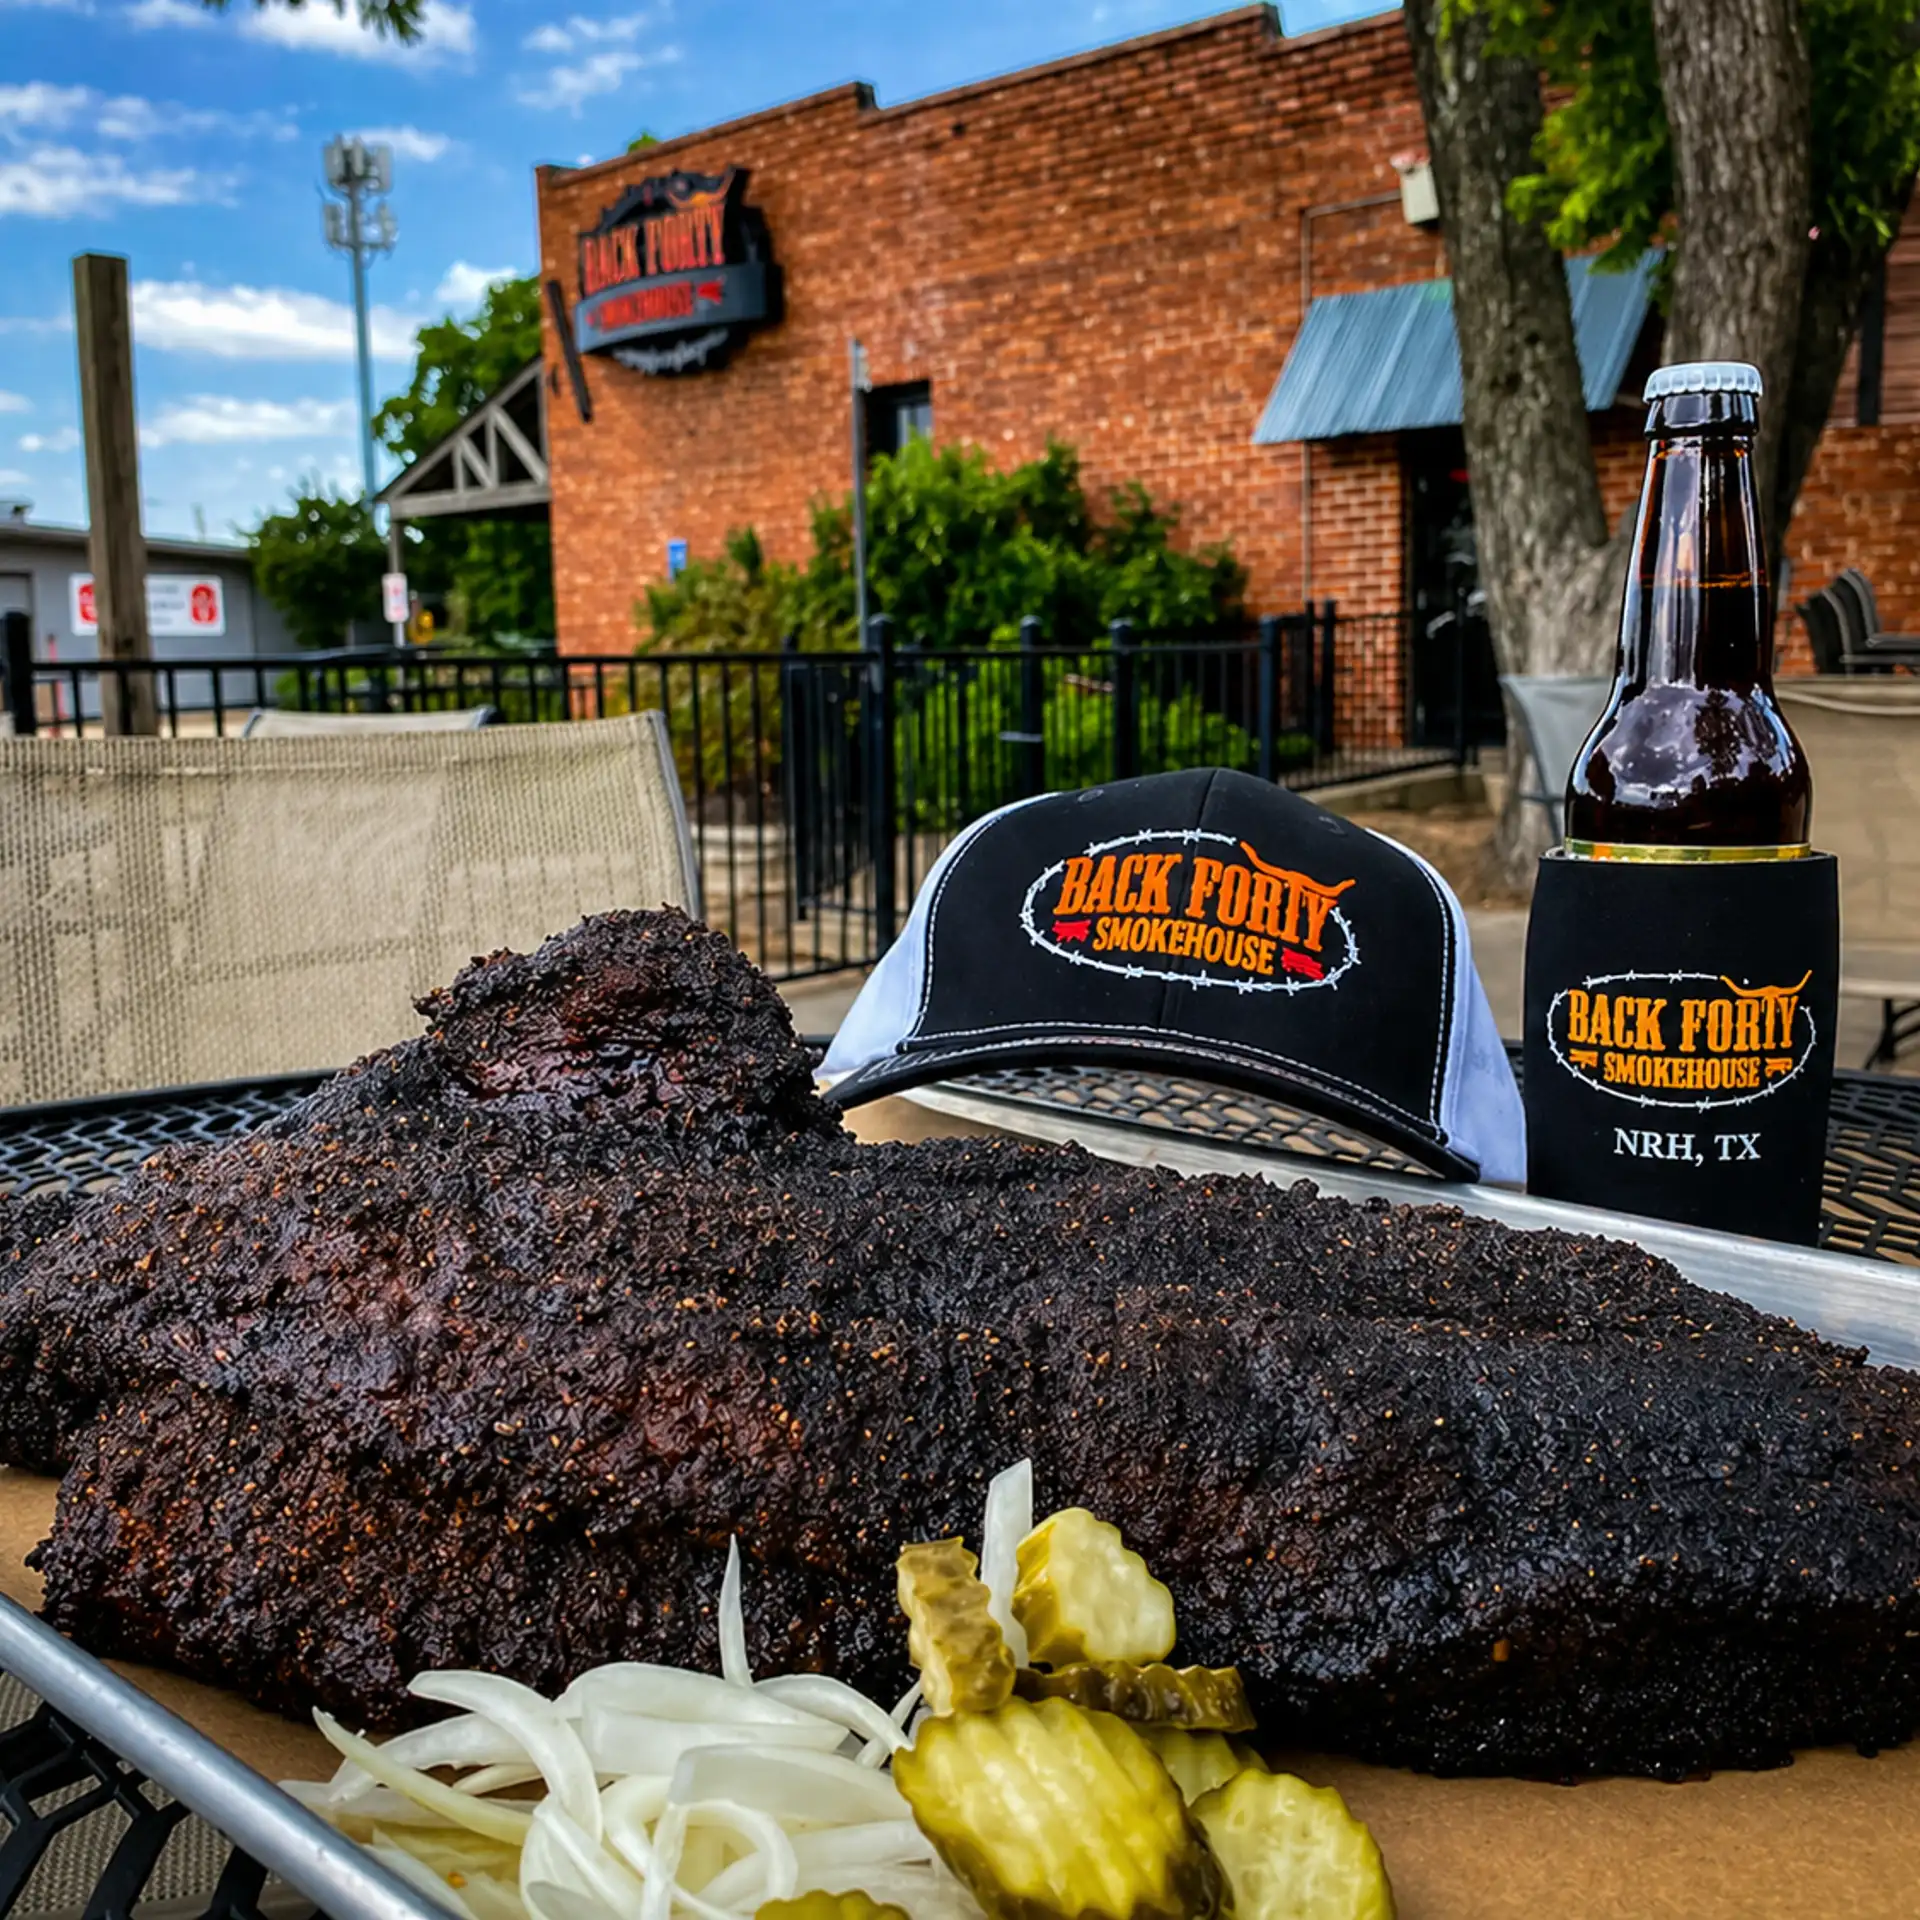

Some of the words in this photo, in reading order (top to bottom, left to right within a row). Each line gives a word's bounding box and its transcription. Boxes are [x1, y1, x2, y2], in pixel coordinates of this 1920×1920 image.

[1053, 853, 1182, 916] BACK
[1185, 856, 1339, 952] FORTY
[1092, 916, 1278, 976] SMOKEHOUSE
[1568, 989, 1668, 1051] BACK
[1678, 995, 1799, 1053] FORTY
[1604, 1051, 1761, 1090] SMOKEHOUSE
[1613, 1127, 1705, 1167] NRH,
[1713, 1133, 1762, 1160] TX
